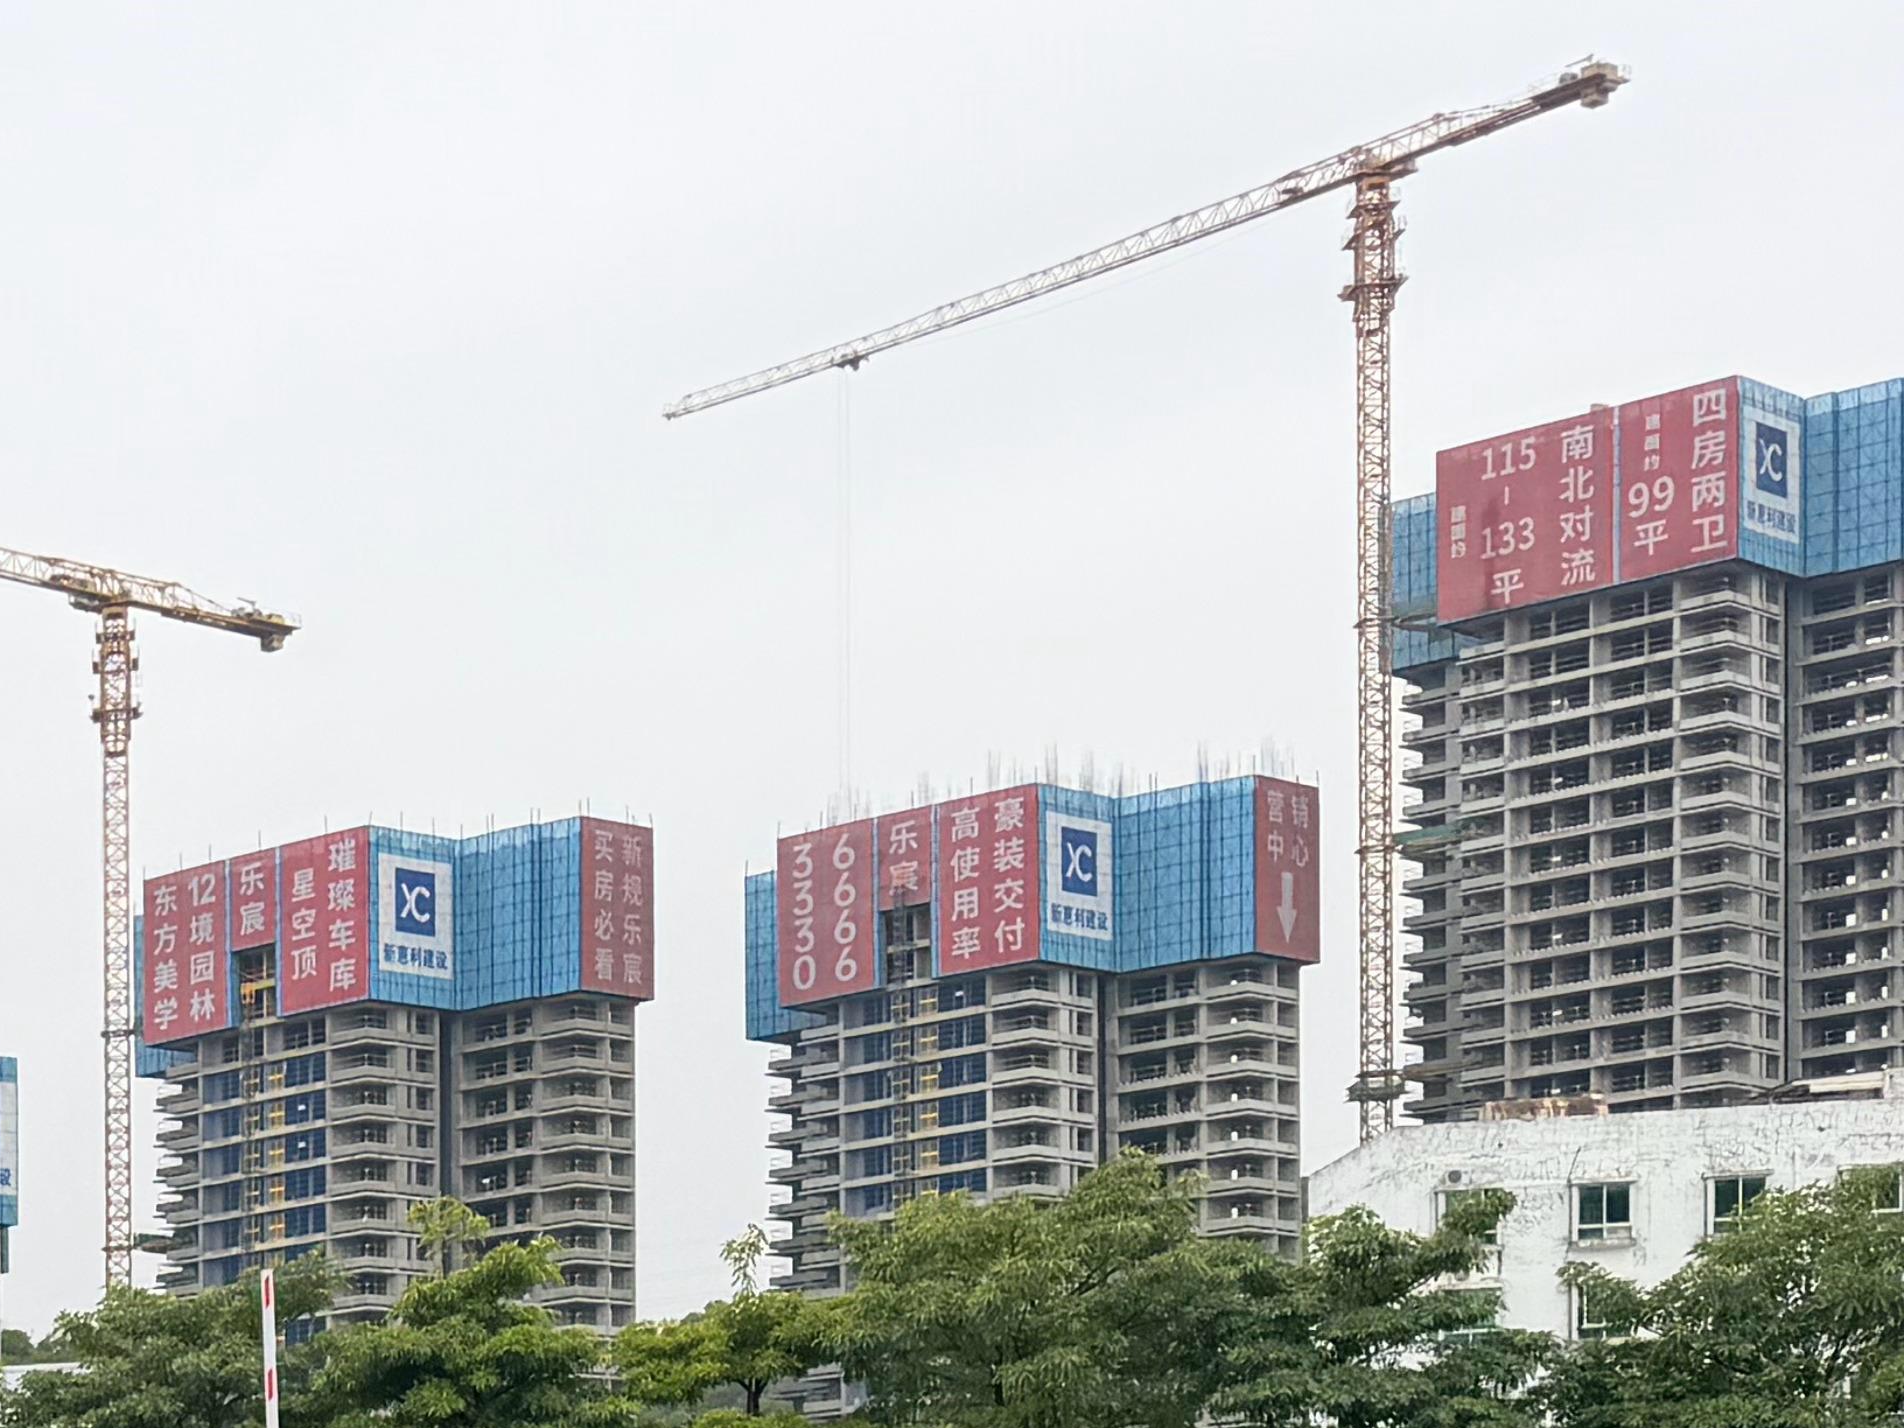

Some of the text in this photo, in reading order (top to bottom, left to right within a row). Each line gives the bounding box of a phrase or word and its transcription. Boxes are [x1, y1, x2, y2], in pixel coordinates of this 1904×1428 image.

[1558, 423, 1596, 587] 南北对流
[1627, 475, 1676, 519] 99
[1690, 387, 1729, 554] 四房两卫
[239, 861, 265, 936] 乐宸
[290, 866, 318, 981] 星空顶
[327, 837, 357, 993] 璀璨车库
[593, 828, 615, 982] 买房必看
[621, 834, 643, 986] 新规乐宸
[949, 805, 982, 960] 高使用率
[992, 796, 1026, 955] 豪装交付
[152, 884, 179, 1031] 东方美学
